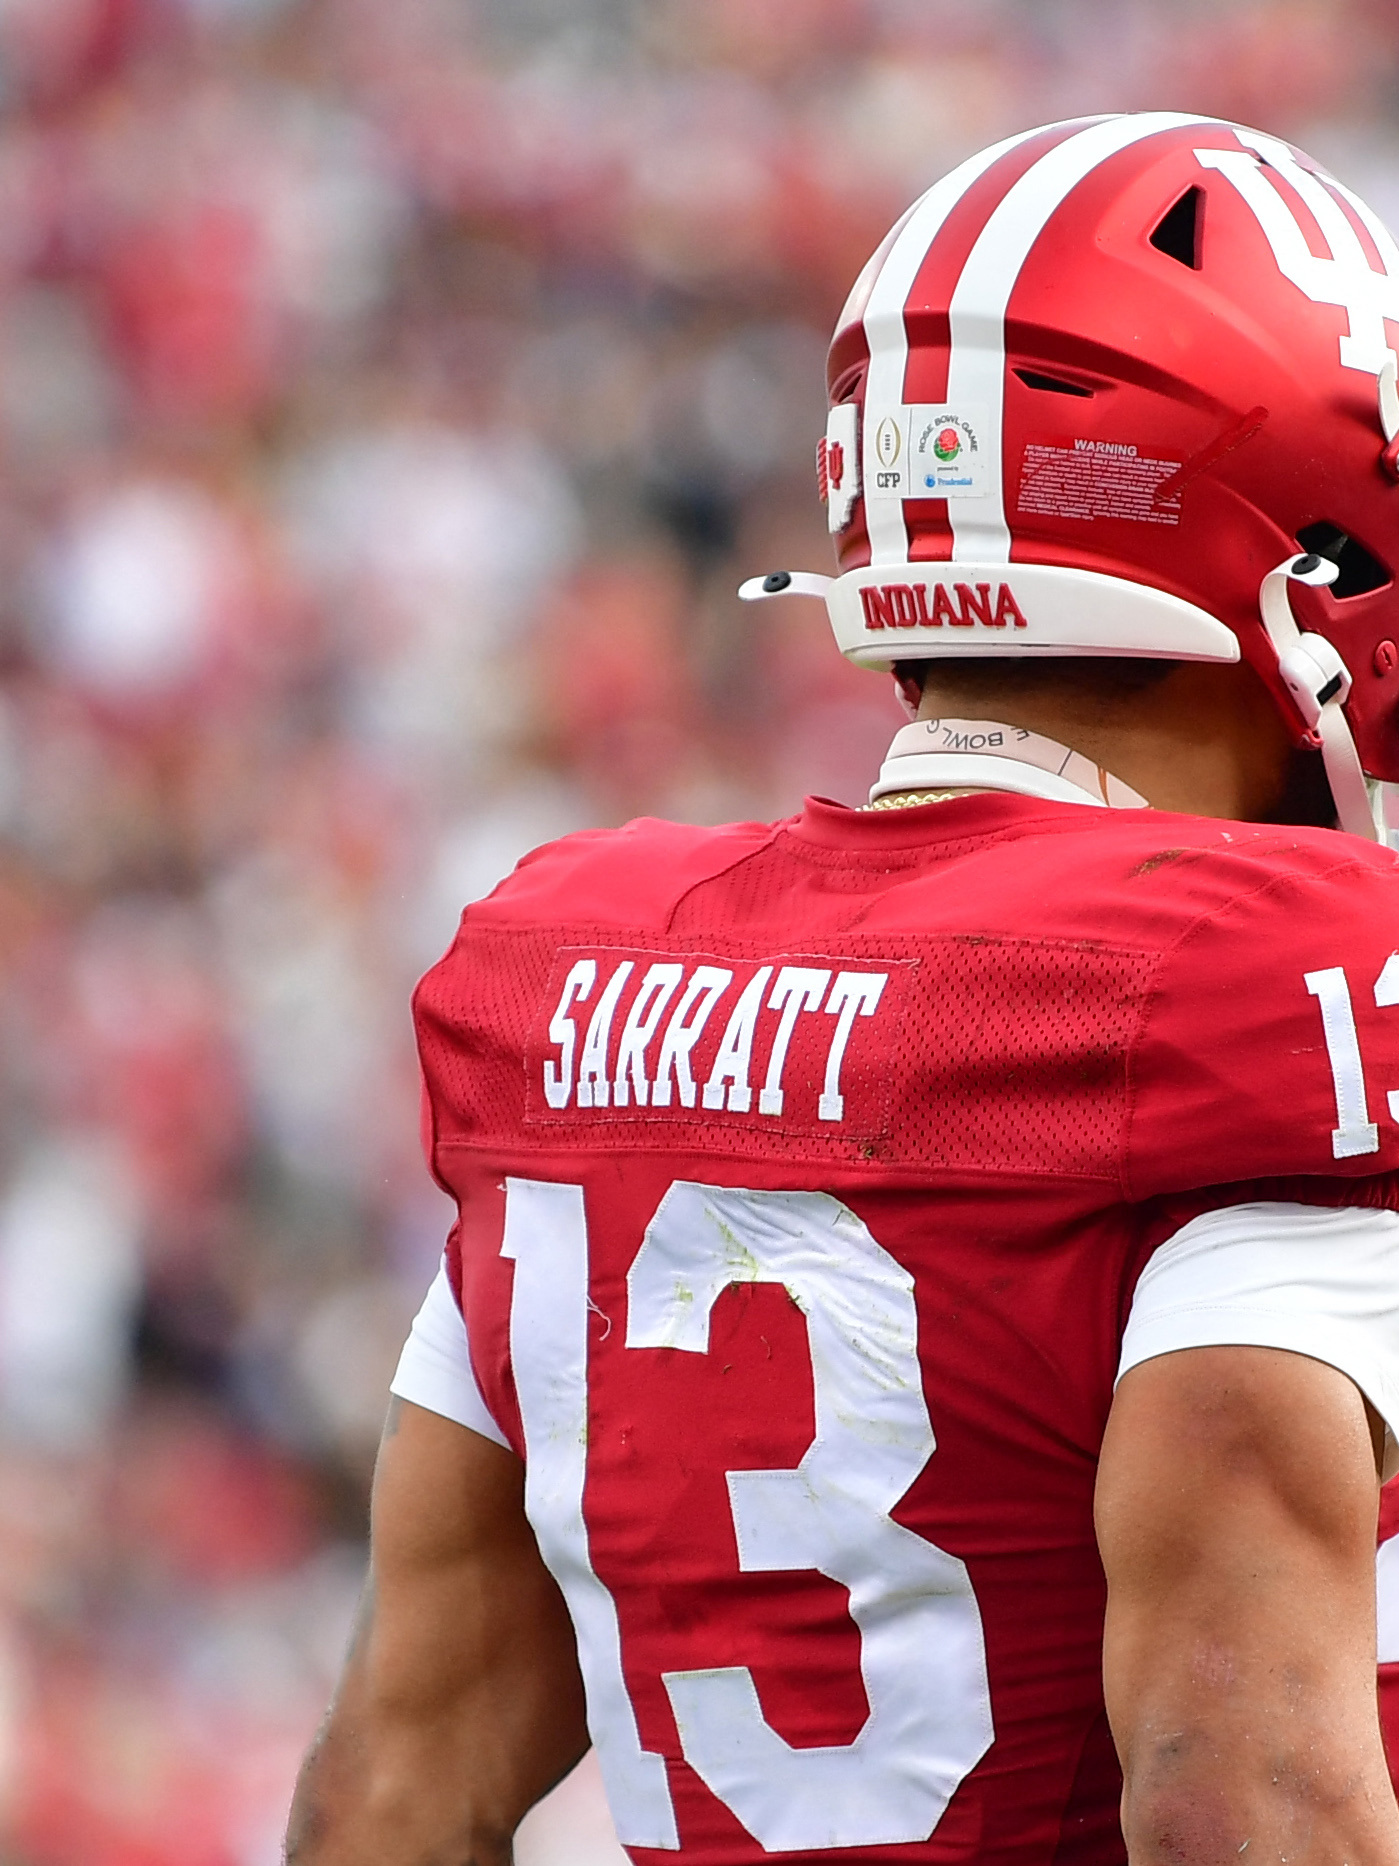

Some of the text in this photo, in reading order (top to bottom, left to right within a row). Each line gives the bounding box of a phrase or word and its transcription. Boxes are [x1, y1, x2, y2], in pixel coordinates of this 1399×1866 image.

[934, 414, 960, 426] BOWL
[1074, 439, 1138, 457] WARNING
[876, 472, 901, 488] CFP
[937, 477, 973, 486] Prudential
[858, 582, 1028, 630] INDIANA
[942, 726, 1005, 750] BOWL
[543, 959, 889, 1121] SARRATT
[500, 1176, 996, 1851] 13
